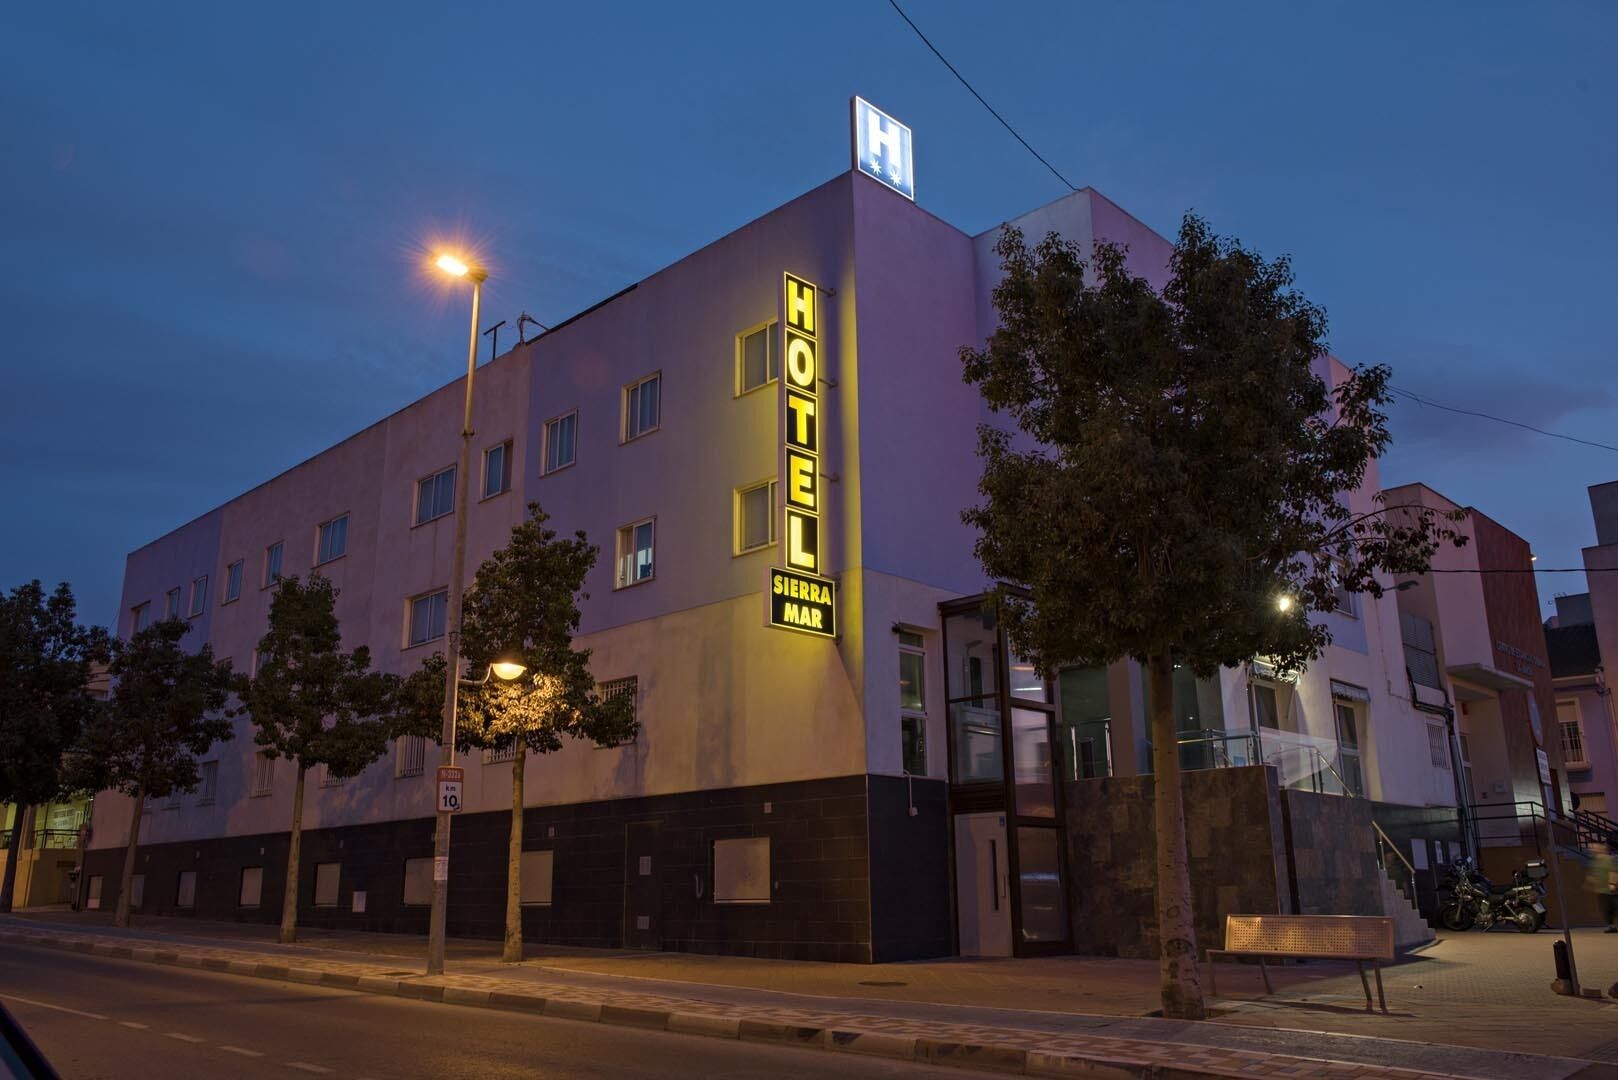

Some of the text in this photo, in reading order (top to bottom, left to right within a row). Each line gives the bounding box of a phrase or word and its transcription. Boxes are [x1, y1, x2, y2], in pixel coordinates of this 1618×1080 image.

[868, 108, 900, 169] H
[787, 279, 815, 569] HOTEL
[773, 574, 832, 606] SIERRA
[783, 602, 823, 629] MAR
[443, 794, 458, 808] 10
[446, 783, 456, 791] km
